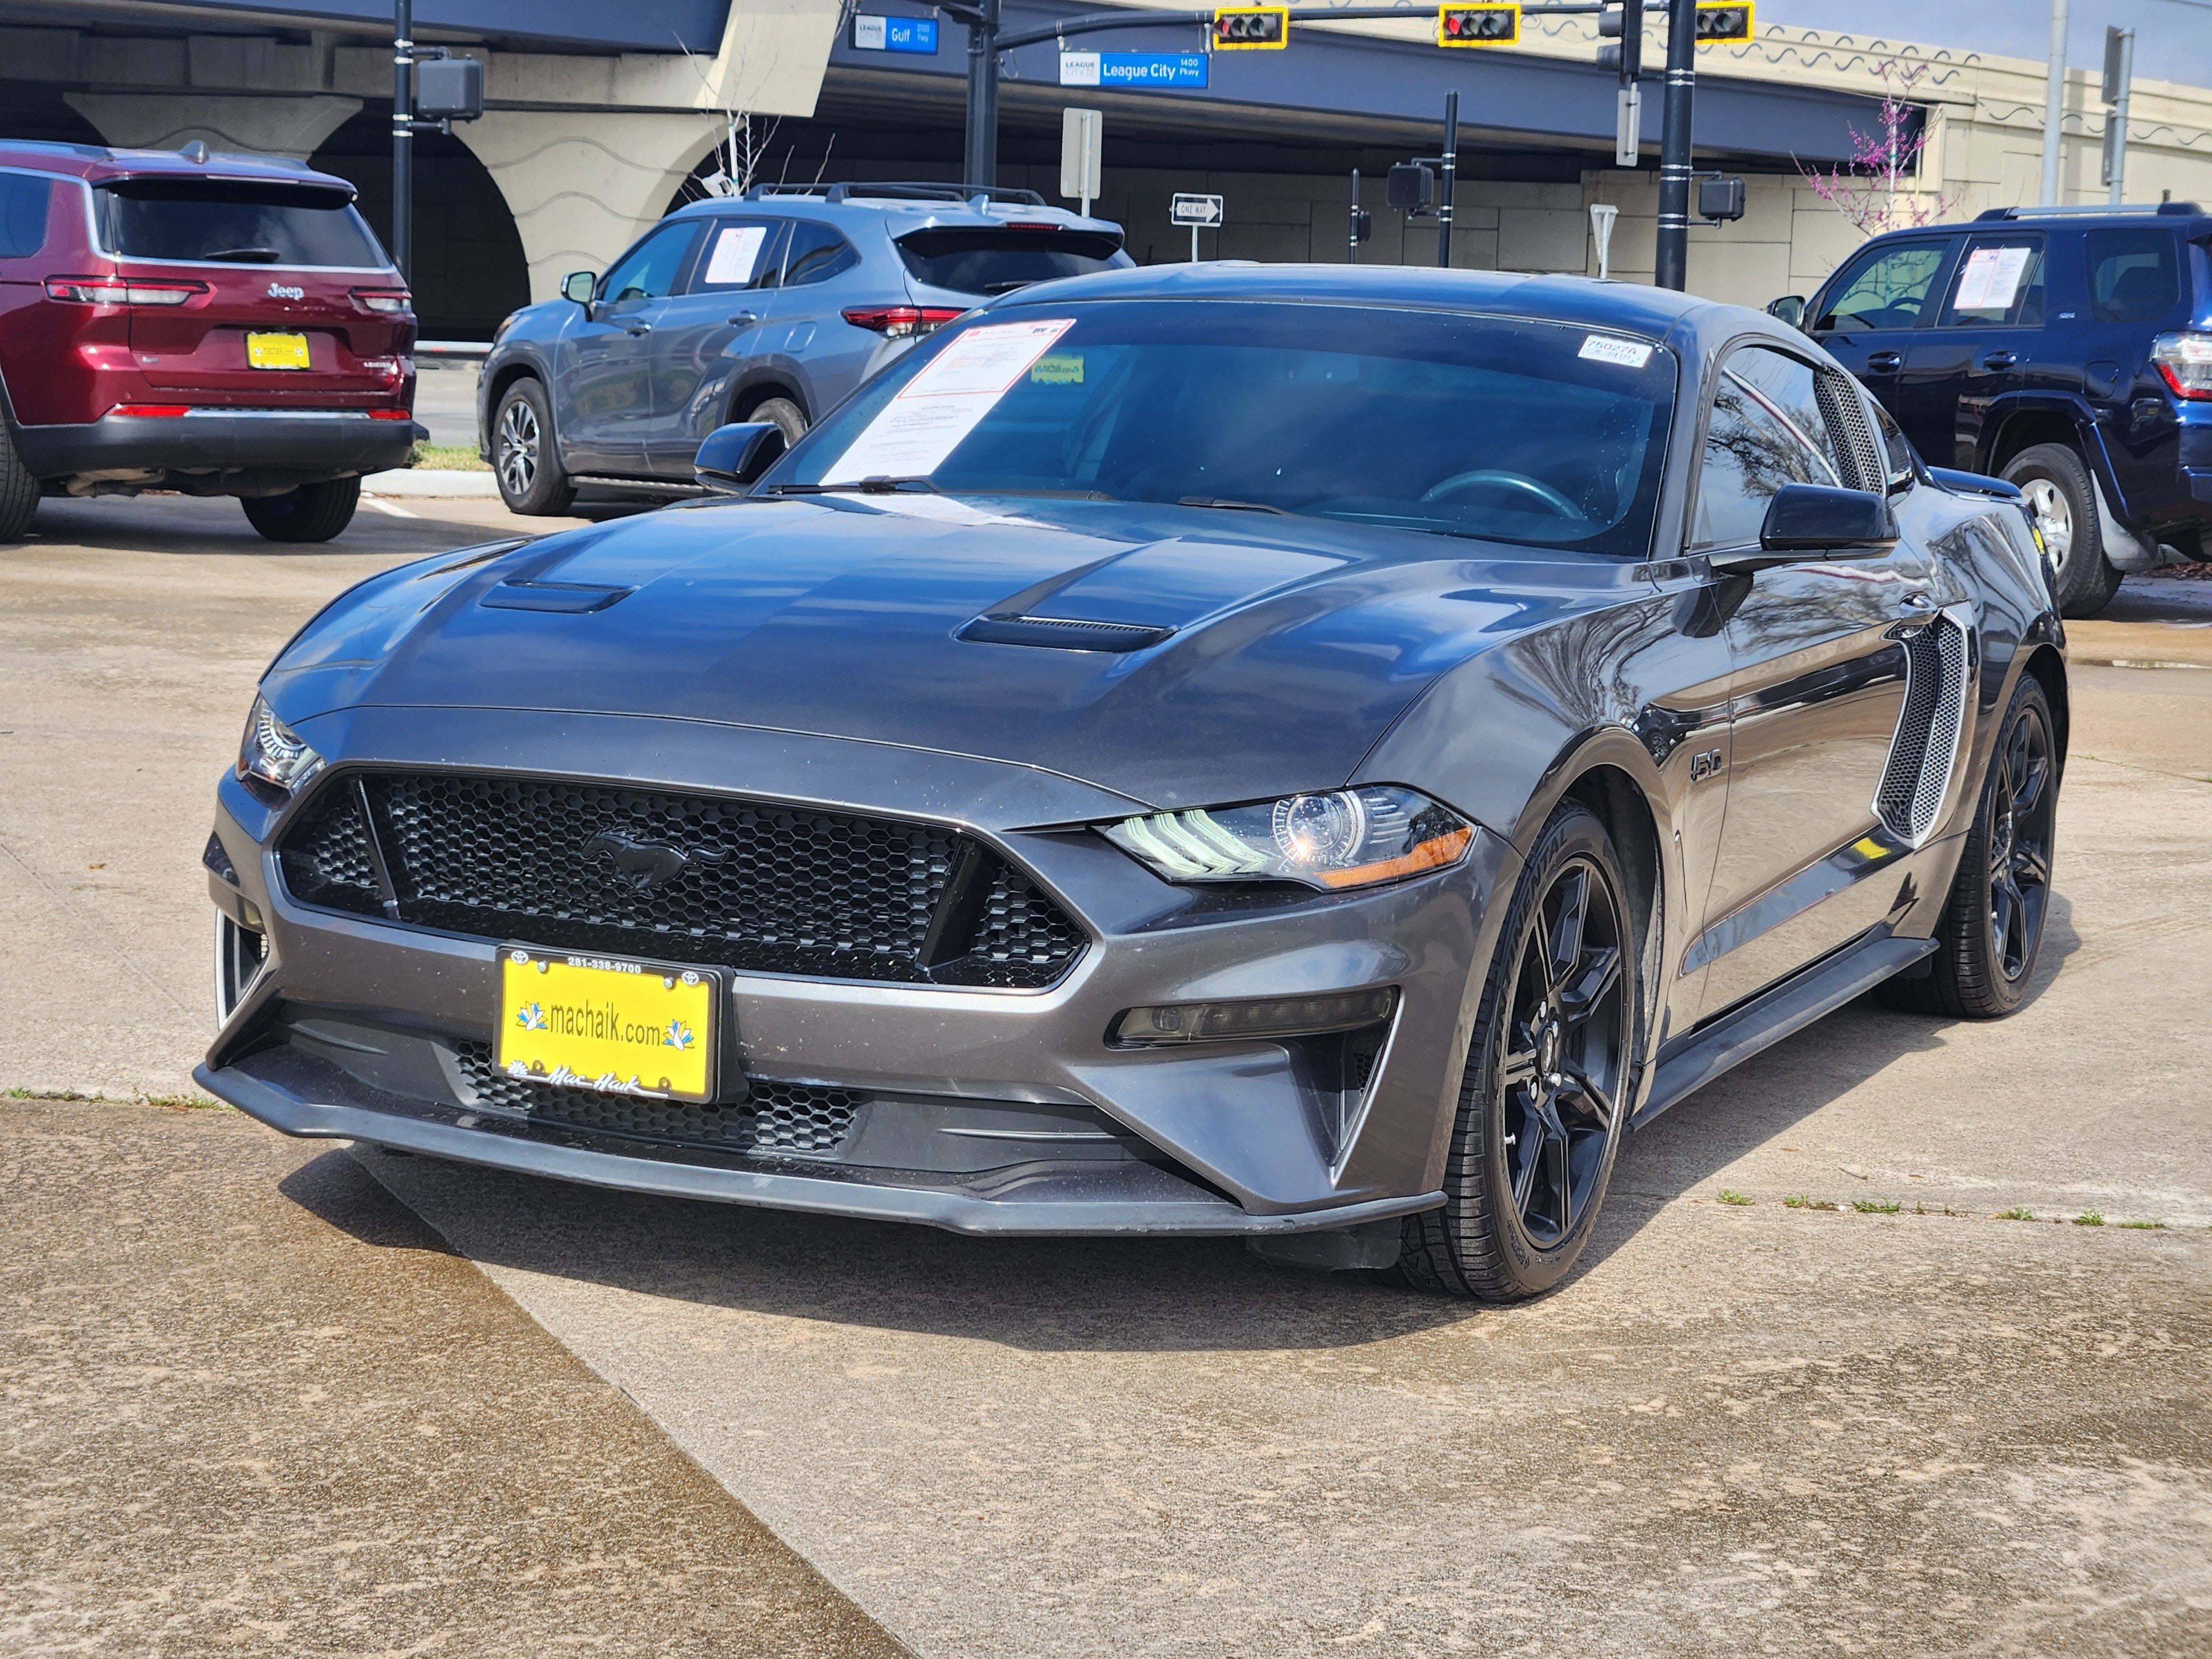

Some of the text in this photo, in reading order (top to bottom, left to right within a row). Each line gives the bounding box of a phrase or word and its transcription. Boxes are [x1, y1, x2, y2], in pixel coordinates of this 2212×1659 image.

[891, 28, 911, 42] Gulf
[1181, 58, 1198, 66] 1400
[1103, 62, 1147, 81] League
[1150, 63, 1176, 81] City
[1180, 67, 1199, 77] Pkwy
[1181, 205, 1206, 213] ONE WAY
[268, 282, 304, 300] Jeep
[1588, 340, 1637, 355] 75027A
[567, 957, 641, 973] 281-338-9700
[550, 999, 660, 1046] machaik.com
[546, 1064, 593, 1086] Mac
